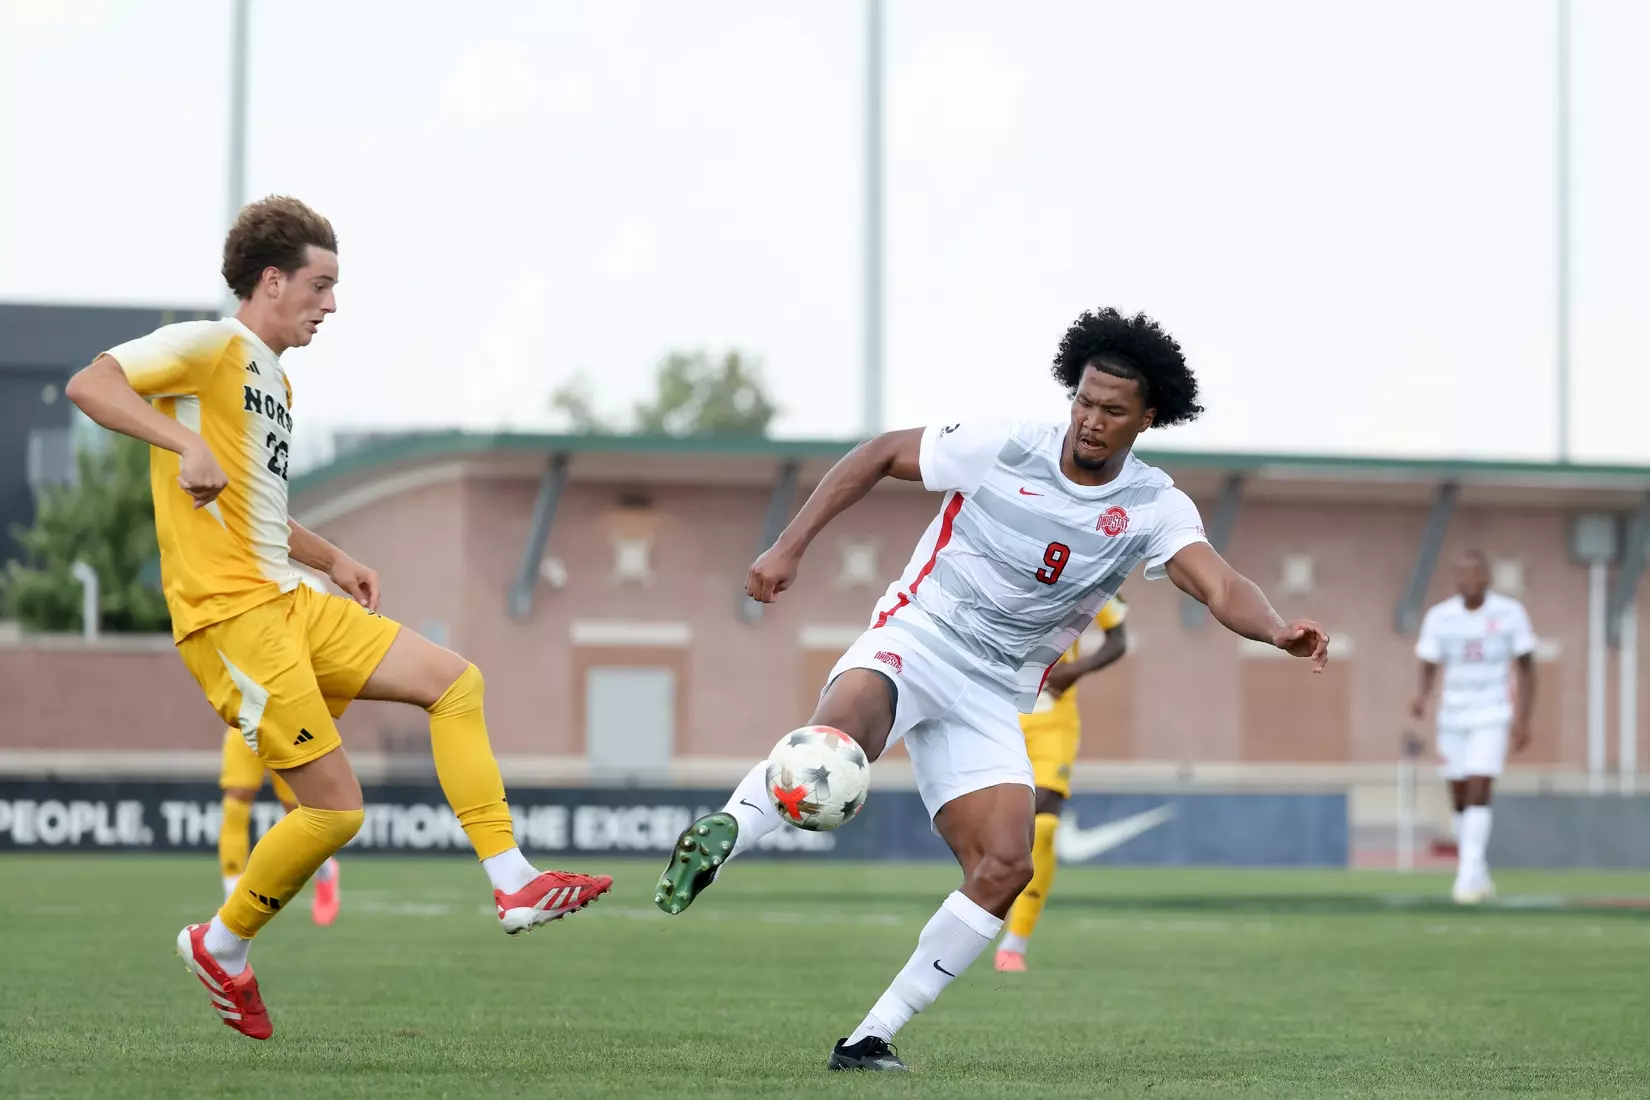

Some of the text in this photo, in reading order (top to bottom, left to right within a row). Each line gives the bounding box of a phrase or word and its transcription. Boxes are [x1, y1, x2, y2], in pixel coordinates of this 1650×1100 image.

[1035, 541, 1071, 585] 9
[0, 799, 153, 846] PEOPLE.
[160, 801, 222, 846] TH
[251, 802, 472, 848] TITION
[510, 804, 569, 850] HE
